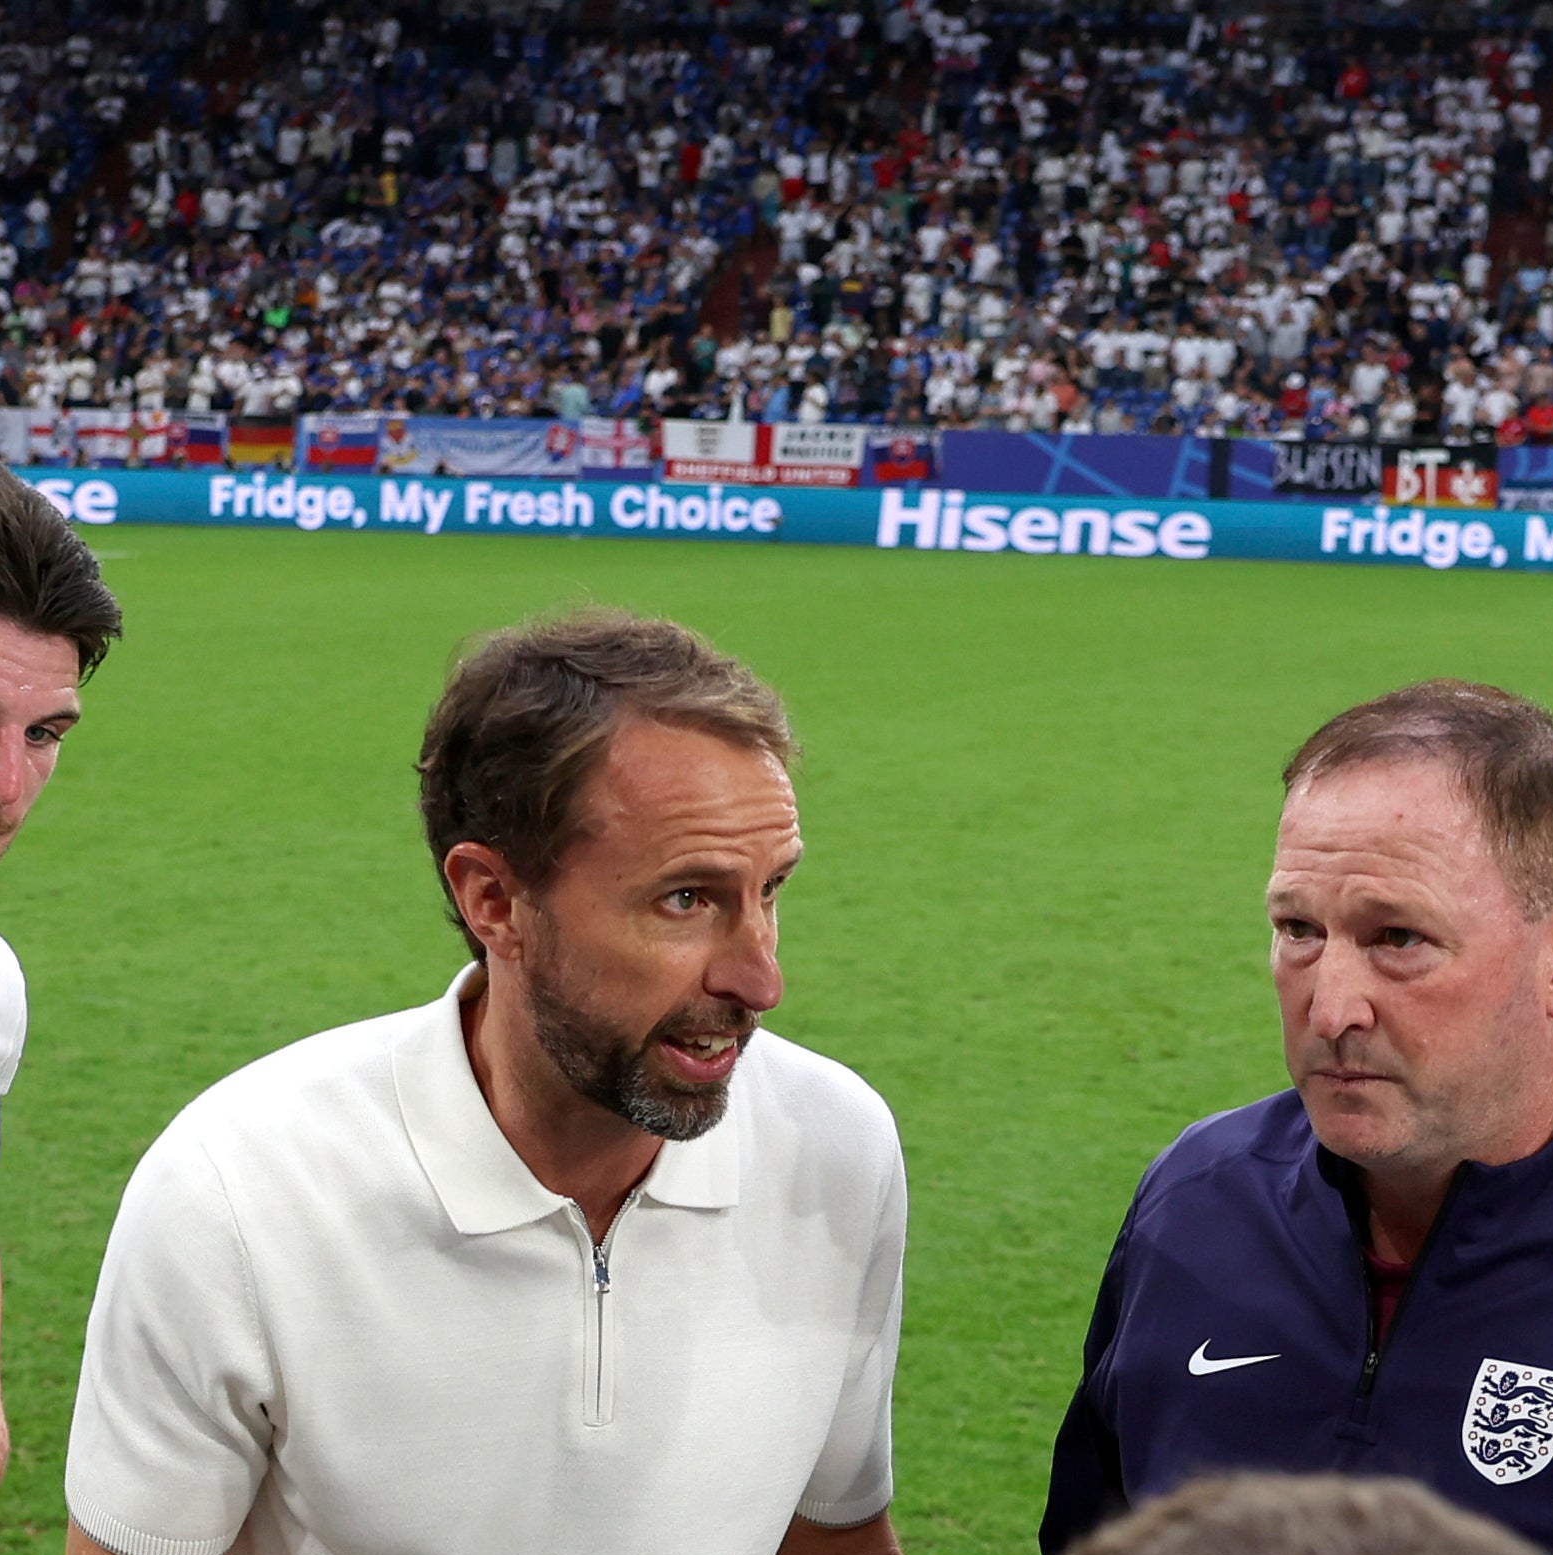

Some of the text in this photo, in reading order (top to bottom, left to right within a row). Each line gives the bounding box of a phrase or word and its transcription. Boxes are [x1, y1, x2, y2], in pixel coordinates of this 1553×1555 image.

[209, 472, 781, 535] Fridge, My Fresh Choice
[876, 488, 1212, 560] Hisense
[1321, 505, 1508, 568] Fridge,
